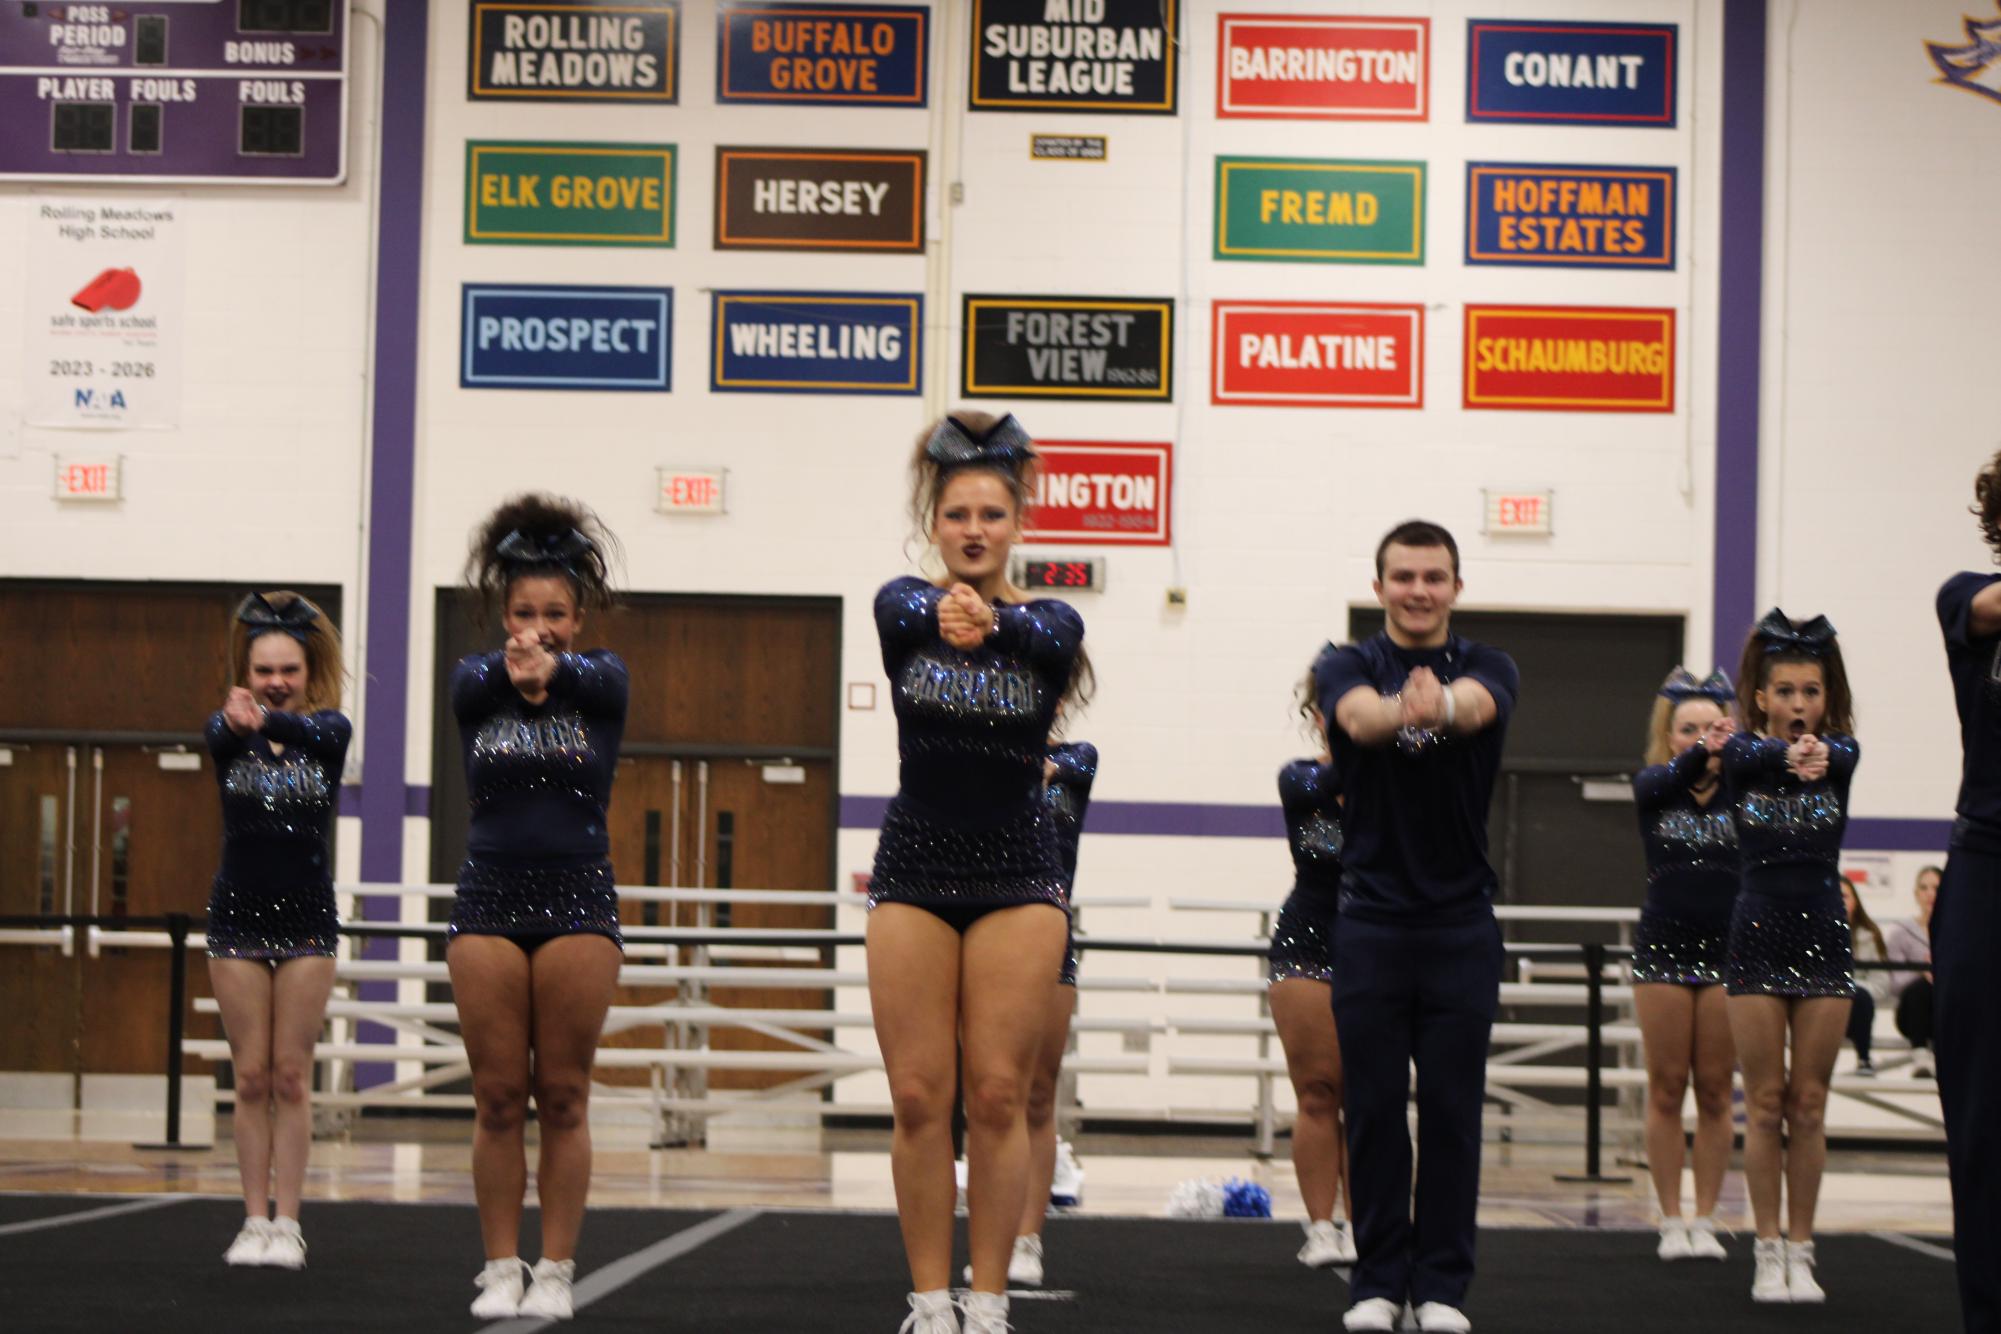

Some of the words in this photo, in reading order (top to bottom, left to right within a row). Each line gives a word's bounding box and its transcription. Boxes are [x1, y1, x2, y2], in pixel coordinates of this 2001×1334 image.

[67, 5, 109, 23] POSS
[50, 25, 127, 47] PERIOD
[504, 14, 645, 50] ROLLING
[751, 21, 896, 55] BUFFALO
[984, 24, 1162, 61] SUBURBAN
[224, 41, 296, 64] BONUS
[491, 52, 658, 87] MEADOWS
[1230, 47, 1417, 84] BARRINGTON
[769, 58, 879, 91] GROVE
[1008, 60, 1135, 95] LEAGUE
[1504, 52, 1644, 89] CONANT
[38, 77, 116, 100] PLAYER
[130, 79, 197, 101] FOULS
[239, 80, 306, 103] FOULS
[481, 174, 541, 207] ELK
[550, 177, 660, 210] GROVE
[753, 179, 889, 216] HERSEY
[1260, 189, 1379, 226] FREMD
[1493, 179, 1649, 216] HOFFMAN
[41, 205, 96, 222] Rolling
[101, 206, 174, 222] Meadows
[59, 224, 95, 242] High
[100, 225, 155, 240] School
[1499, 216, 1645, 253] ESTATES
[478, 316, 656, 354] PROSPECT
[730, 322, 902, 361] WHEELING
[1006, 311, 1135, 347] FOREST
[50, 360, 93, 377] 2023
[111, 361, 156, 378] 2026
[1027, 347, 1108, 382] VIEW
[1239, 333, 1397, 371] PALATINE
[1476, 337, 1665, 375] SCHAUMBURG
[67, 464, 108, 493] EXIT
[672, 475, 713, 506] EXIT
[1499, 496, 1541, 526] EXIT
